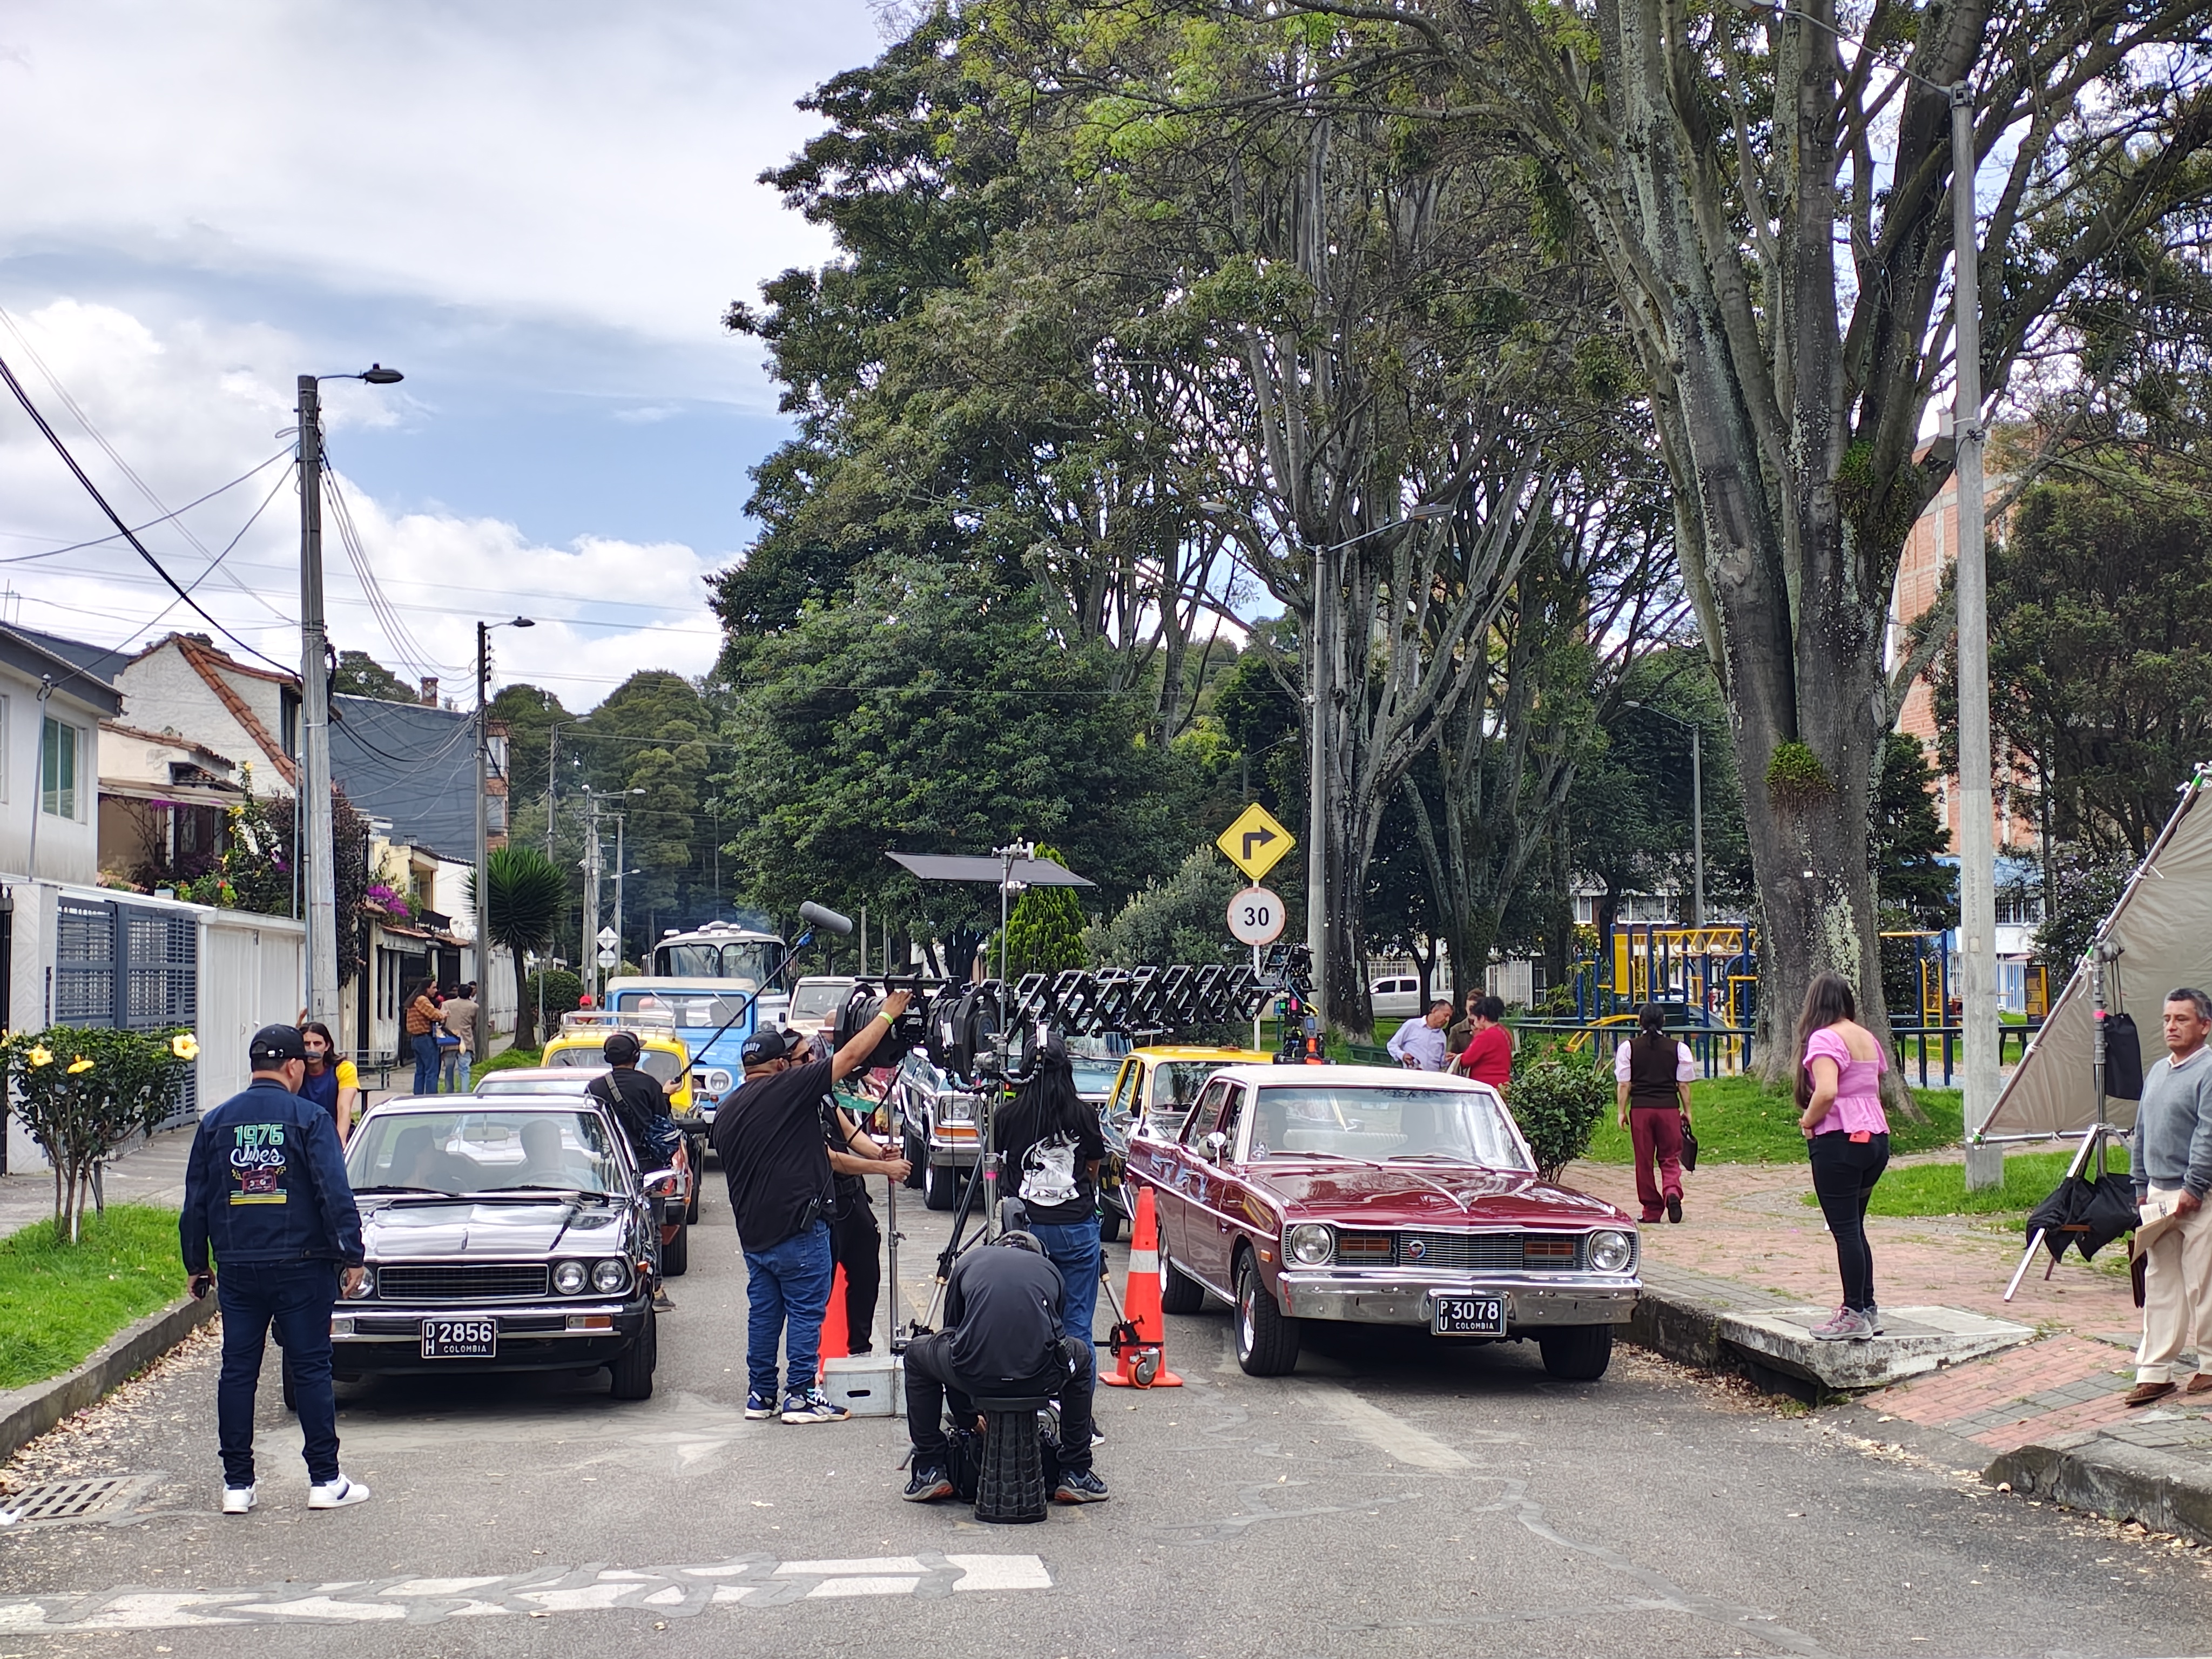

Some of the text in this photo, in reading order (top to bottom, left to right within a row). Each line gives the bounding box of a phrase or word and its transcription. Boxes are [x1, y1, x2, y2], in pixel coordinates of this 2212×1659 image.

[1244, 907, 1269, 926] 30
[234, 1124, 284, 1147] 1976
[231, 1144, 285, 1166] Vibes
[1452, 1301, 1499, 1319] 3078
[439, 1323, 492, 1343] 2856
[443, 1345, 487, 1353] COLOMBIA
